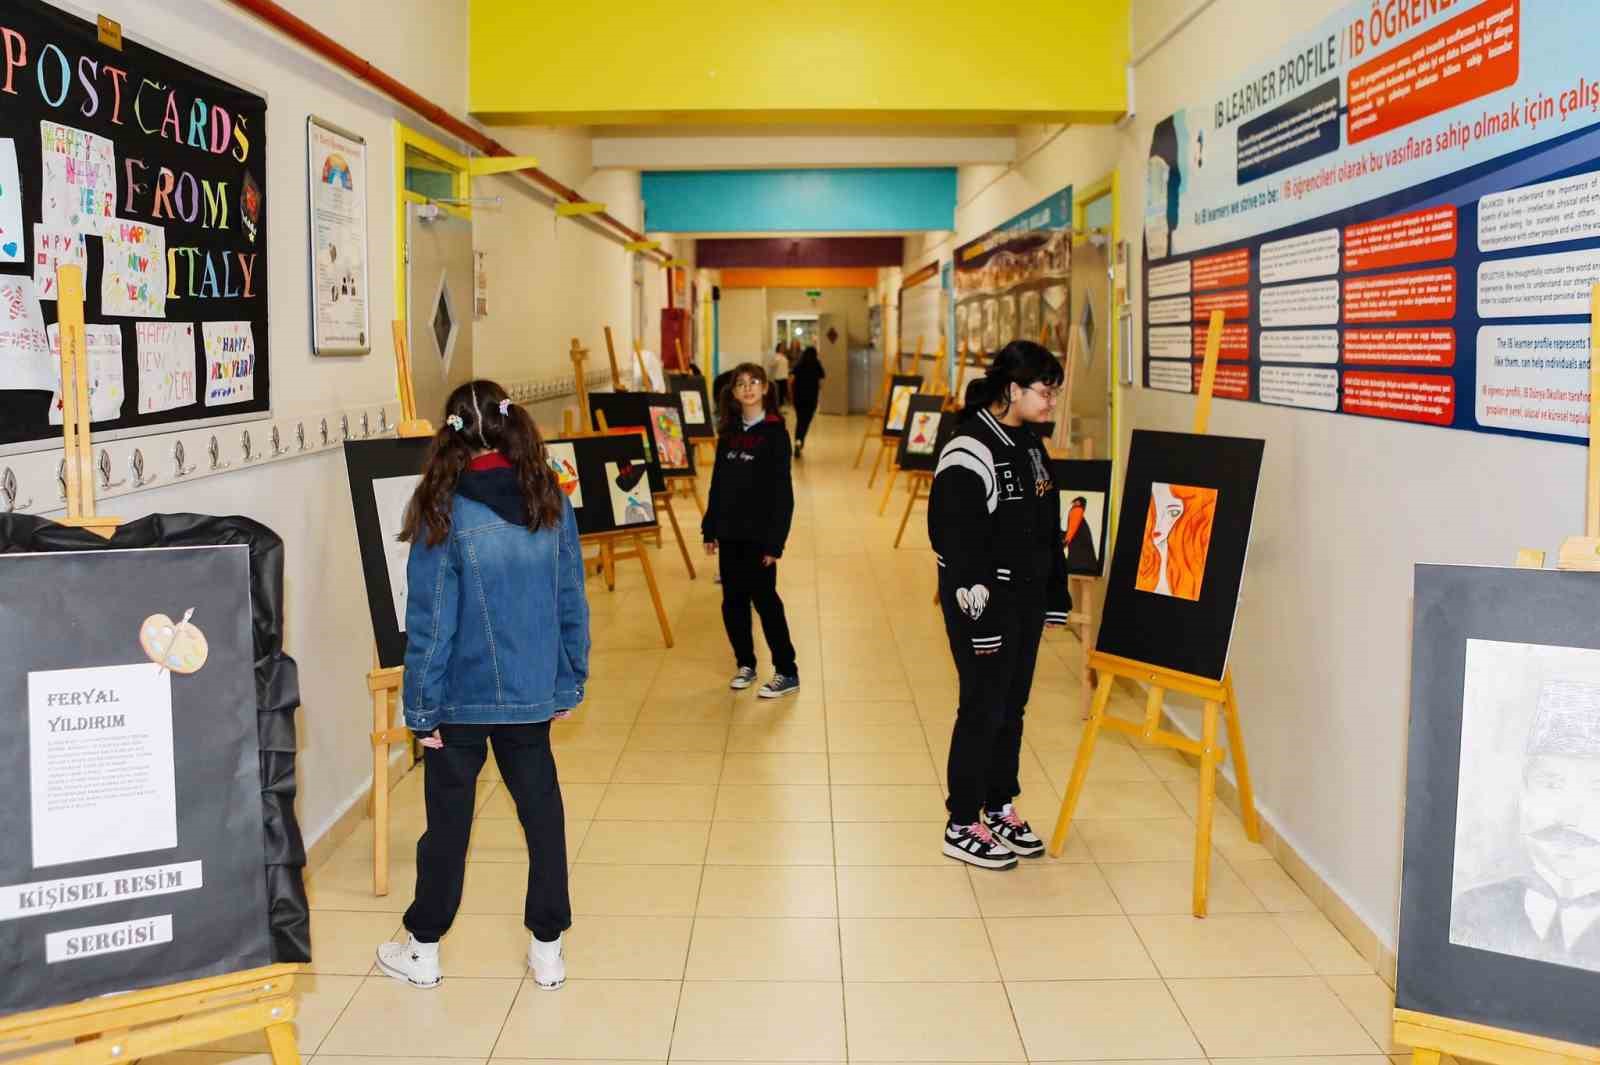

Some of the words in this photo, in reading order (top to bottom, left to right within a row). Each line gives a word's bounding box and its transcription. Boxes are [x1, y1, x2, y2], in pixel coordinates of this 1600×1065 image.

[1, 26, 250, 163] POSTCARDS
[1215, 101, 1224, 128] IB
[1226, 71, 1276, 123] LEARNER
[1279, 34, 1336, 96] PROFILE
[1349, 19, 1365, 59] IB
[1370, 152, 1383, 173] bu
[1436, 120, 1470, 151] sahip
[1474, 102, 1520, 140] olmak
[1524, 92, 1553, 130] için
[125, 158, 229, 229] FROM
[166, 247, 257, 299] ITALY
[47, 688, 120, 706] FERYAL
[48, 714, 126, 733] YILDIRIM
[19, 881, 109, 910] KİŞİSEL
[114, 868, 184, 896] RESİM
[66, 920, 157, 956] SERGİSİ
